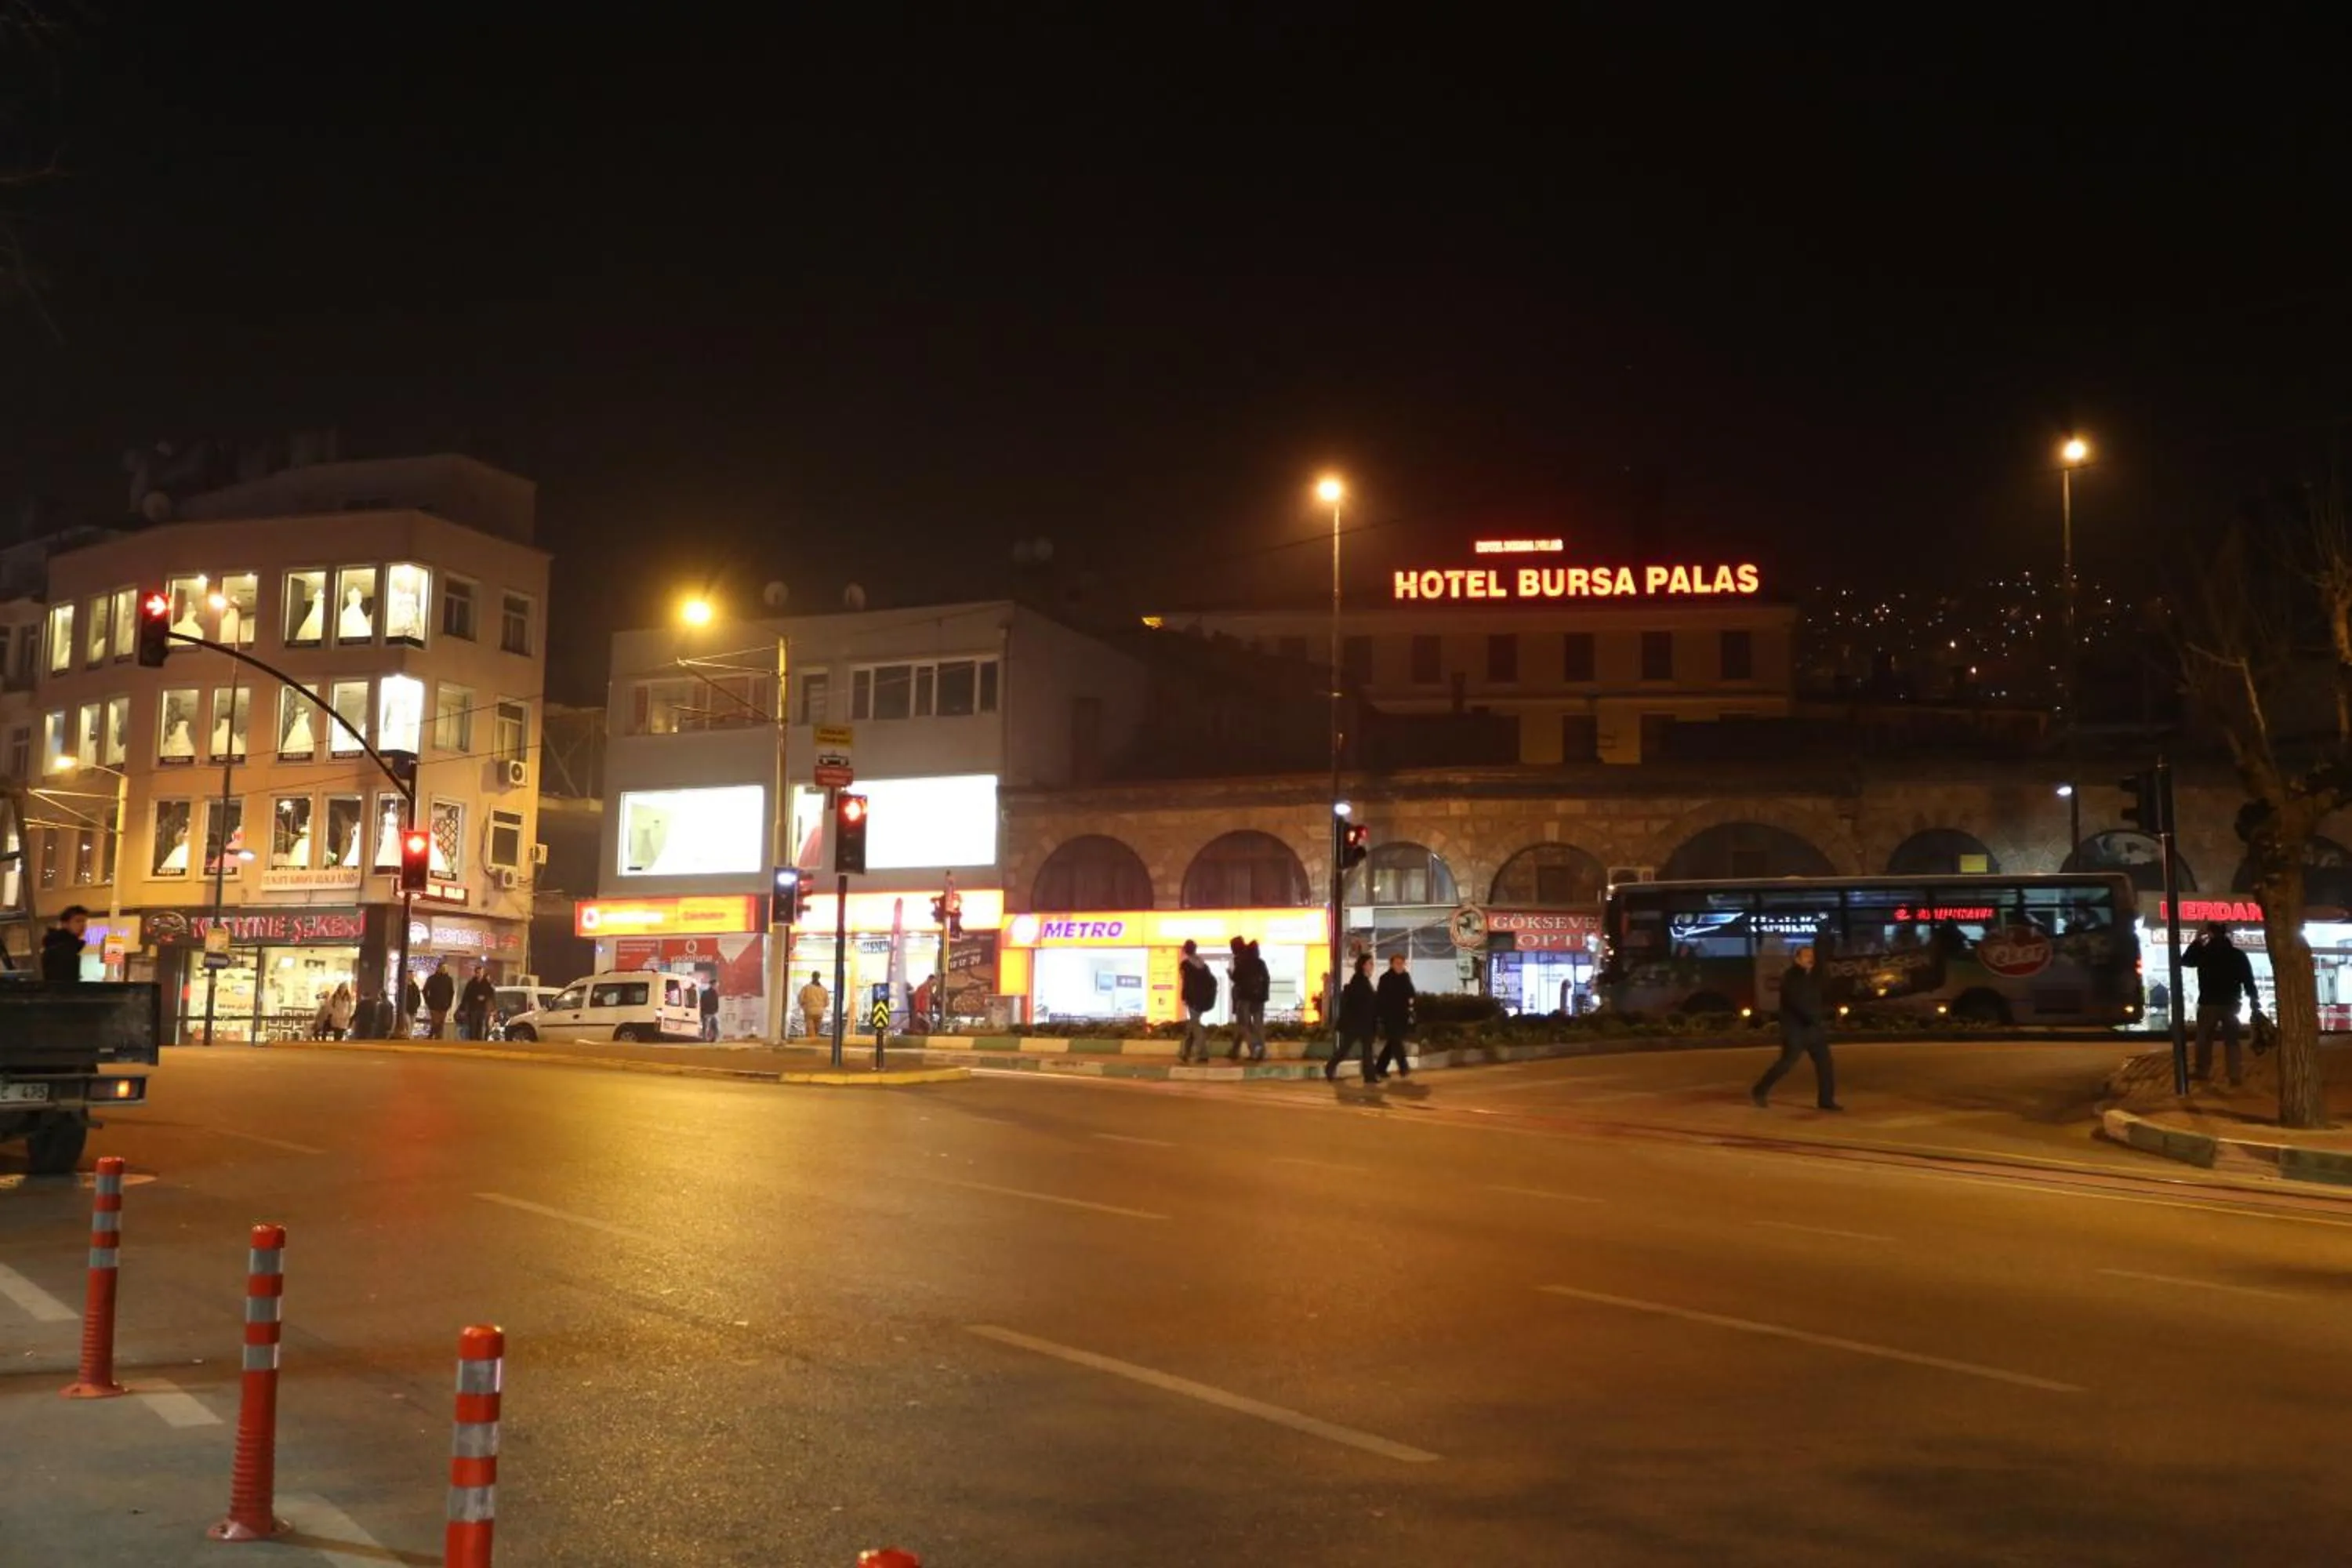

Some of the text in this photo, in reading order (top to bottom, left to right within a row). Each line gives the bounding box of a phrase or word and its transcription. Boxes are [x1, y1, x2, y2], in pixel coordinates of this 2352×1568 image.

[1395, 564, 1759, 599] HOTEL BURSA PALAS
[1044, 921, 1123, 938] METRO
[1493, 913, 1598, 930] GÖKSEVE
